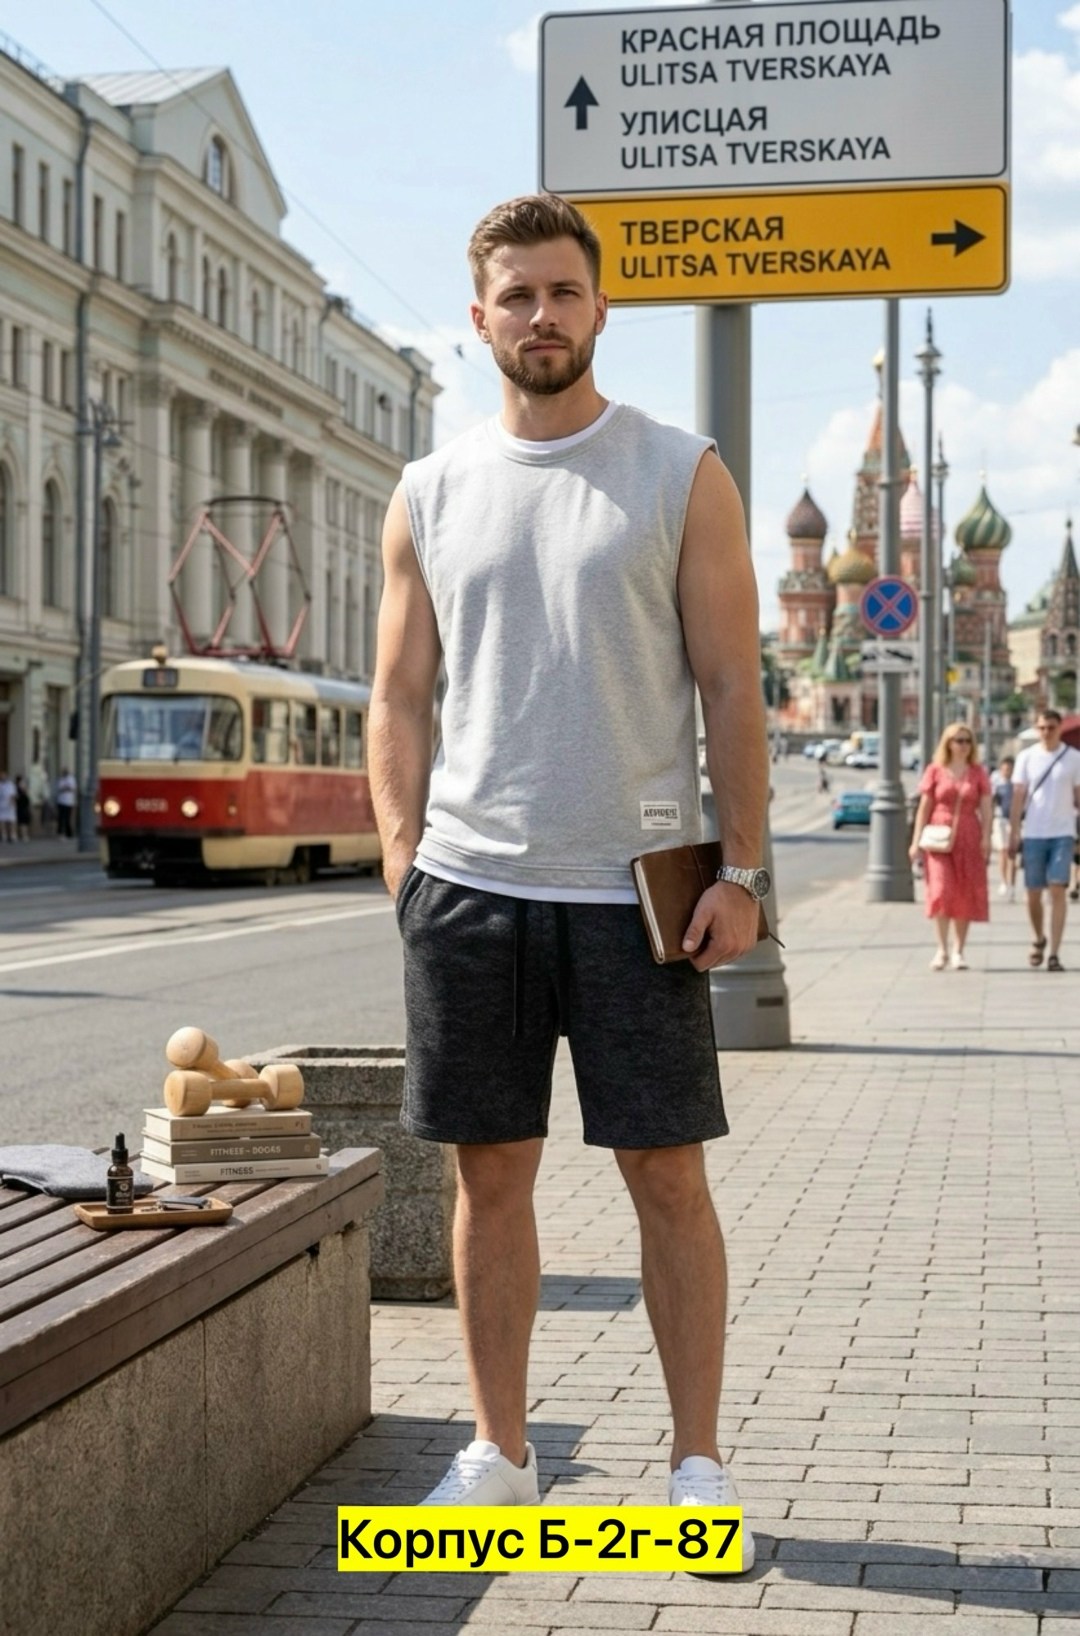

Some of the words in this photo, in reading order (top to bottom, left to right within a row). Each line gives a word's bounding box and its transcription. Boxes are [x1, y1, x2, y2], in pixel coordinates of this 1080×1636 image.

[621, 23, 764, 54] КРАСНАЯ
[775, 15, 941, 46] ПЛОЩАДЬ
[621, 61, 718, 87] ULITSA
[726, 53, 891, 82] TVERSKAYA
[620, 106, 768, 137] УЛИСЦАЯ
[621, 143, 718, 169] ULITSA
[726, 136, 891, 165] TVERSKAYA
[620, 216, 784, 246] ТВЕРСКАЯ
[621, 253, 718, 279] ULITSA
[726, 247, 891, 275] TVERSKAYA
